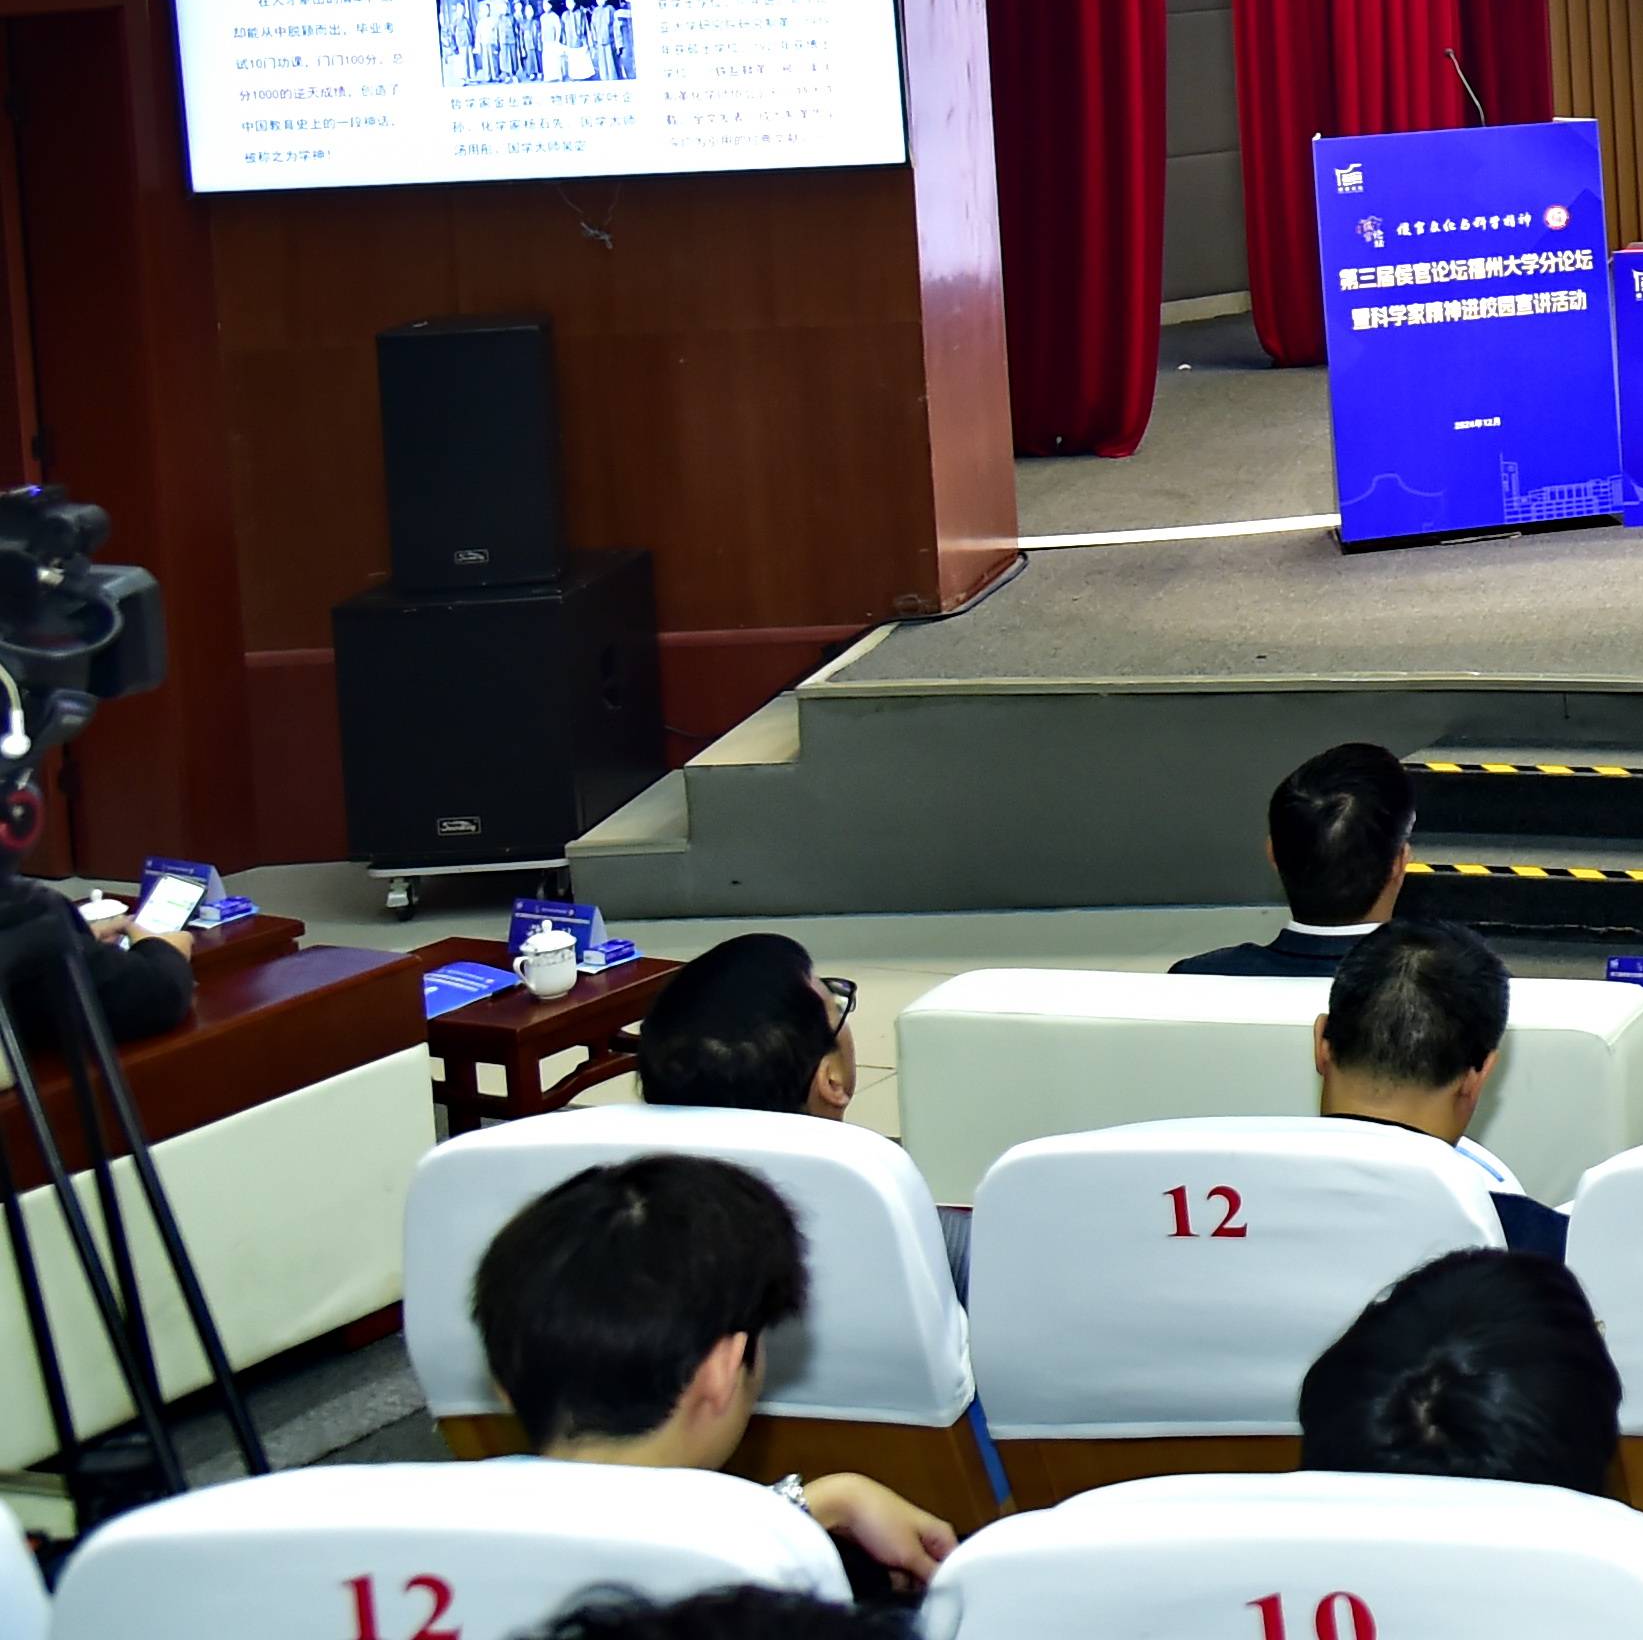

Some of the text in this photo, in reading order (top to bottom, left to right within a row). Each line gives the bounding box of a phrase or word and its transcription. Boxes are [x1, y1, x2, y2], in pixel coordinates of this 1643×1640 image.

[1339, 249, 1593, 290] 第三届侯官论坛福州大学分论坛
[1352, 289, 1587, 330] 暨科学家精神进校园宣讲活动
[1162, 1184, 1252, 1240] 12
[341, 1571, 462, 1640] 12
